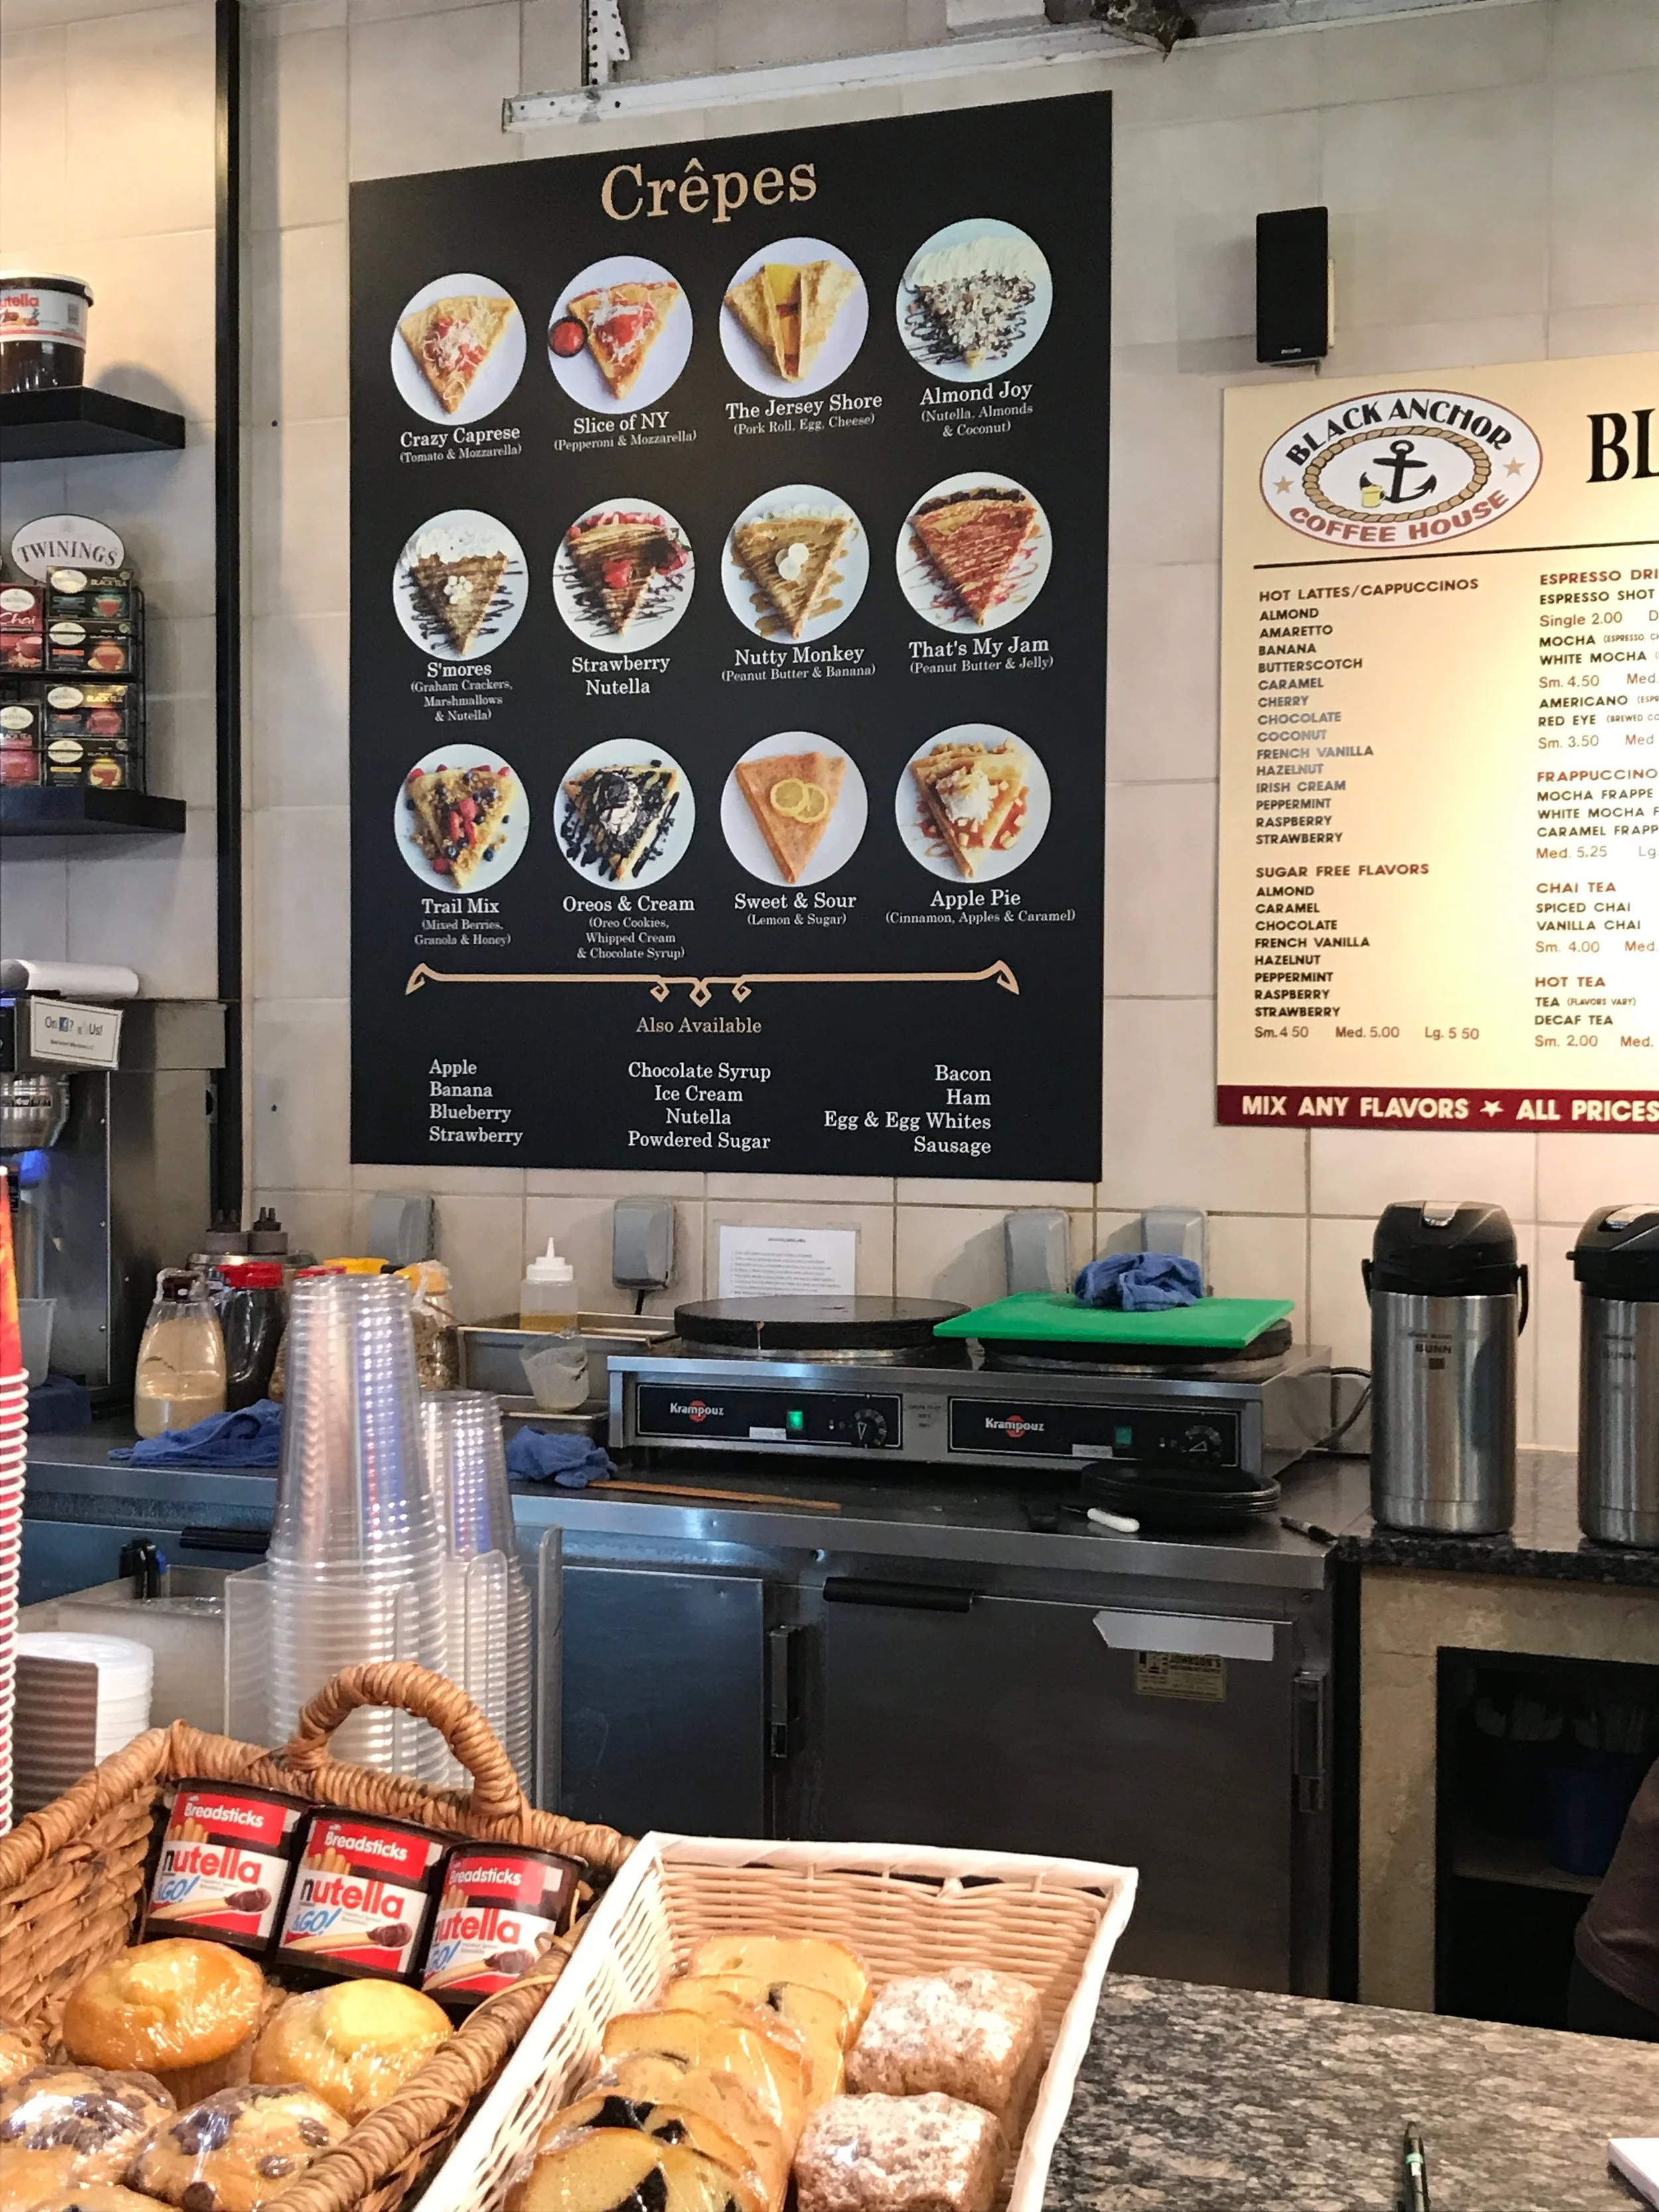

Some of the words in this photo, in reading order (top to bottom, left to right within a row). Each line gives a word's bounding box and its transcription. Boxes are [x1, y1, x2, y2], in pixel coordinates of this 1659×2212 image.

[601, 157, 817, 224] Crêpes
[919, 382, 994, 406] Almond
[999, 380, 1033, 400] Joy
[725, 402, 760, 420] The
[764, 399, 824, 417] Jersey
[829, 393, 883, 411] Shore
[921, 407, 975, 422] (Nutella,
[978, 402, 1033, 418] Almonds
[573, 417, 615, 435] Slice
[619, 413, 638, 431] of
[640, 411, 670, 429] NY
[733, 421, 765, 435] (Pork
[769, 419, 796, 433] Roll,
[800, 418, 825, 432] Egg,
[828, 413, 875, 428] Cheese)
[942, 425, 954, 437] &
[956, 420, 1011, 436] Coconut)
[400, 431, 449, 448] Crazy
[453, 427, 520, 445] Caprese
[553, 439, 614, 453] (Pepperoni
[617, 435, 627, 447] &
[630, 429, 697, 446] Mozzarella)
[1285, 400, 1382, 467] BLACK
[1388, 398, 1512, 451] ANCHOR
[1585, 407, 1659, 483] BL
[1289, 506, 1396, 542] COFFEE
[1408, 490, 1509, 540] HOUSE
[17, 540, 118, 567] TWININGS
[1259, 589, 1291, 603] HOT
[1297, 578, 1479, 601] LATTES/CAPPUCCINOS
[1540, 591, 1610, 605] ESPRESSO
[1617, 589, 1655, 601] SHOT
[1259, 607, 1319, 622] ALMOND
[1539, 614, 1586, 628] Single
[1591, 611, 1623, 625] 2.00
[1259, 624, 1333, 639] AMARETTO
[735, 649, 788, 668] Nutty
[792, 644, 865, 664] Monkey
[908, 640, 968, 658] That's
[972, 637, 1003, 658] My
[1007, 636, 1049, 654] Jam
[1258, 642, 1317, 656] BANANA
[571, 654, 671, 673] Strawberry
[910, 662, 957, 674] (Peanut
[961, 660, 1002, 672] Butter
[1005, 657, 1016, 670] &
[1019, 656, 1054, 670] Jelly)
[1258, 658, 1363, 674] BUTTERSCOTCH
[1539, 653, 1582, 666] WHITE
[1590, 650, 1647, 663] MOCHA
[427, 662, 492, 678] S'mores
[721, 670, 766, 682] (Peanut
[770, 668, 810, 680] Butter
[812, 666, 822, 678] &
[826, 664, 876, 678] Banana)
[585, 678, 650, 696] Nutella
[1258, 677, 1325, 691] CARAMEL
[1538, 676, 1563, 689] Sm.
[1567, 674, 1600, 688] 4.50
[1539, 695, 1628, 709] AMERICANO
[1537, 768, 1658, 782] FRAPPUCCINO
[1256, 798, 1332, 811] PEPPERMINT
[1256, 815, 1333, 828] RASPBERRY
[1256, 832, 1343, 846] STRAWBERRY
[1256, 866, 1308, 879] SUGAR
[1315, 865, 1350, 877] FREE
[1358, 863, 1429, 876] FLAVORS
[1536, 882, 1579, 894] CHAI
[1587, 881, 1617, 893] TEA
[421, 898, 463, 914] Trail
[467, 897, 500, 914] Mix
[563, 896, 613, 913] Oreos
[617, 895, 632, 912] &
[637, 895, 695, 912] Cream
[735, 893, 788, 910] Sweet
[794, 892, 809, 909] &
[814, 891, 857, 909] Sour
[930, 889, 985, 910] Apple
[990, 889, 1021, 906] Pie
[589, 917, 620, 928] (Oreo
[622, 916, 670, 928] Cookies,
[747, 913, 791, 925] (Lemon
[794, 913, 804, 925] &
[807, 913, 847, 927] Sugar)
[885, 911, 955, 924] (Cinnamon,
[958, 911, 1000, 925] Apples
[1003, 910, 1015, 922] &
[1018, 909, 1076, 922] Caramel)
[1255, 919, 1338, 931] CHOCOLATE
[1536, 921, 1596, 931] VANILLA
[1603, 919, 1641, 930] CHAI
[585, 932, 636, 946] Whipped
[638, 932, 676, 943] Cream
[1254, 937, 1307, 949] FRENCH
[1313, 936, 1370, 948] VANILLA
[577, 947, 587, 959] &
[589, 947, 644, 958] Chocolate
[646, 946, 685, 961] Syrup)
[1254, 954, 1321, 966] HAZELNUT
[1534, 976, 1569, 988] HOT
[1576, 976, 1606, 988] TEA
[1534, 996, 1560, 1007] TEA
[636, 1016, 674, 1033] Also
[678, 1017, 762, 1033] Available
[1370, 1025, 1400, 1039] 5.00
[429, 1059, 477, 1078] Apple
[628, 1061, 713, 1078] Chocolate
[718, 1062, 771, 1082] Syrup
[934, 1065, 991, 1082] Bacon
[429, 1080, 493, 1097] Banana
[654, 1084, 680, 1101] Ice
[685, 1084, 744, 1102] Cream
[946, 1088, 991, 1106] Ham
[429, 1103, 512, 1123] Blueberry
[666, 1107, 731, 1125] Nutella
[1242, 1095, 1287, 1116] MIX
[1297, 1096, 1349, 1117] ANY
[1360, 1096, 1470, 1120] FLAVORS
[1516, 1099, 1561, 1120] ALL
[1571, 1100, 1659, 1122] PRICES
[824, 1110, 859, 1131] Egg
[863, 1111, 879, 1128] &
[885, 1111, 921, 1132] Egg
[925, 1112, 991, 1130] Whites
[429, 1126, 524, 1146] Strawberry
[628, 1130, 713, 1147] Powdered
[718, 1132, 771, 1152] Sugar
[914, 1135, 991, 1157] Sausage
[1415, 1343, 1452, 1354] BUNN
[670, 1402, 725, 1418] Krampouz
[985, 1417, 1045, 1433] Krampouz
[184, 1802, 265, 1828] Breadsticks
[324, 1830, 409, 1862] Breadsticks
[162, 1846, 262, 1885] nutella
[448, 1866, 522, 1886] Breadsticks
[300, 1877, 405, 1920] nutella
